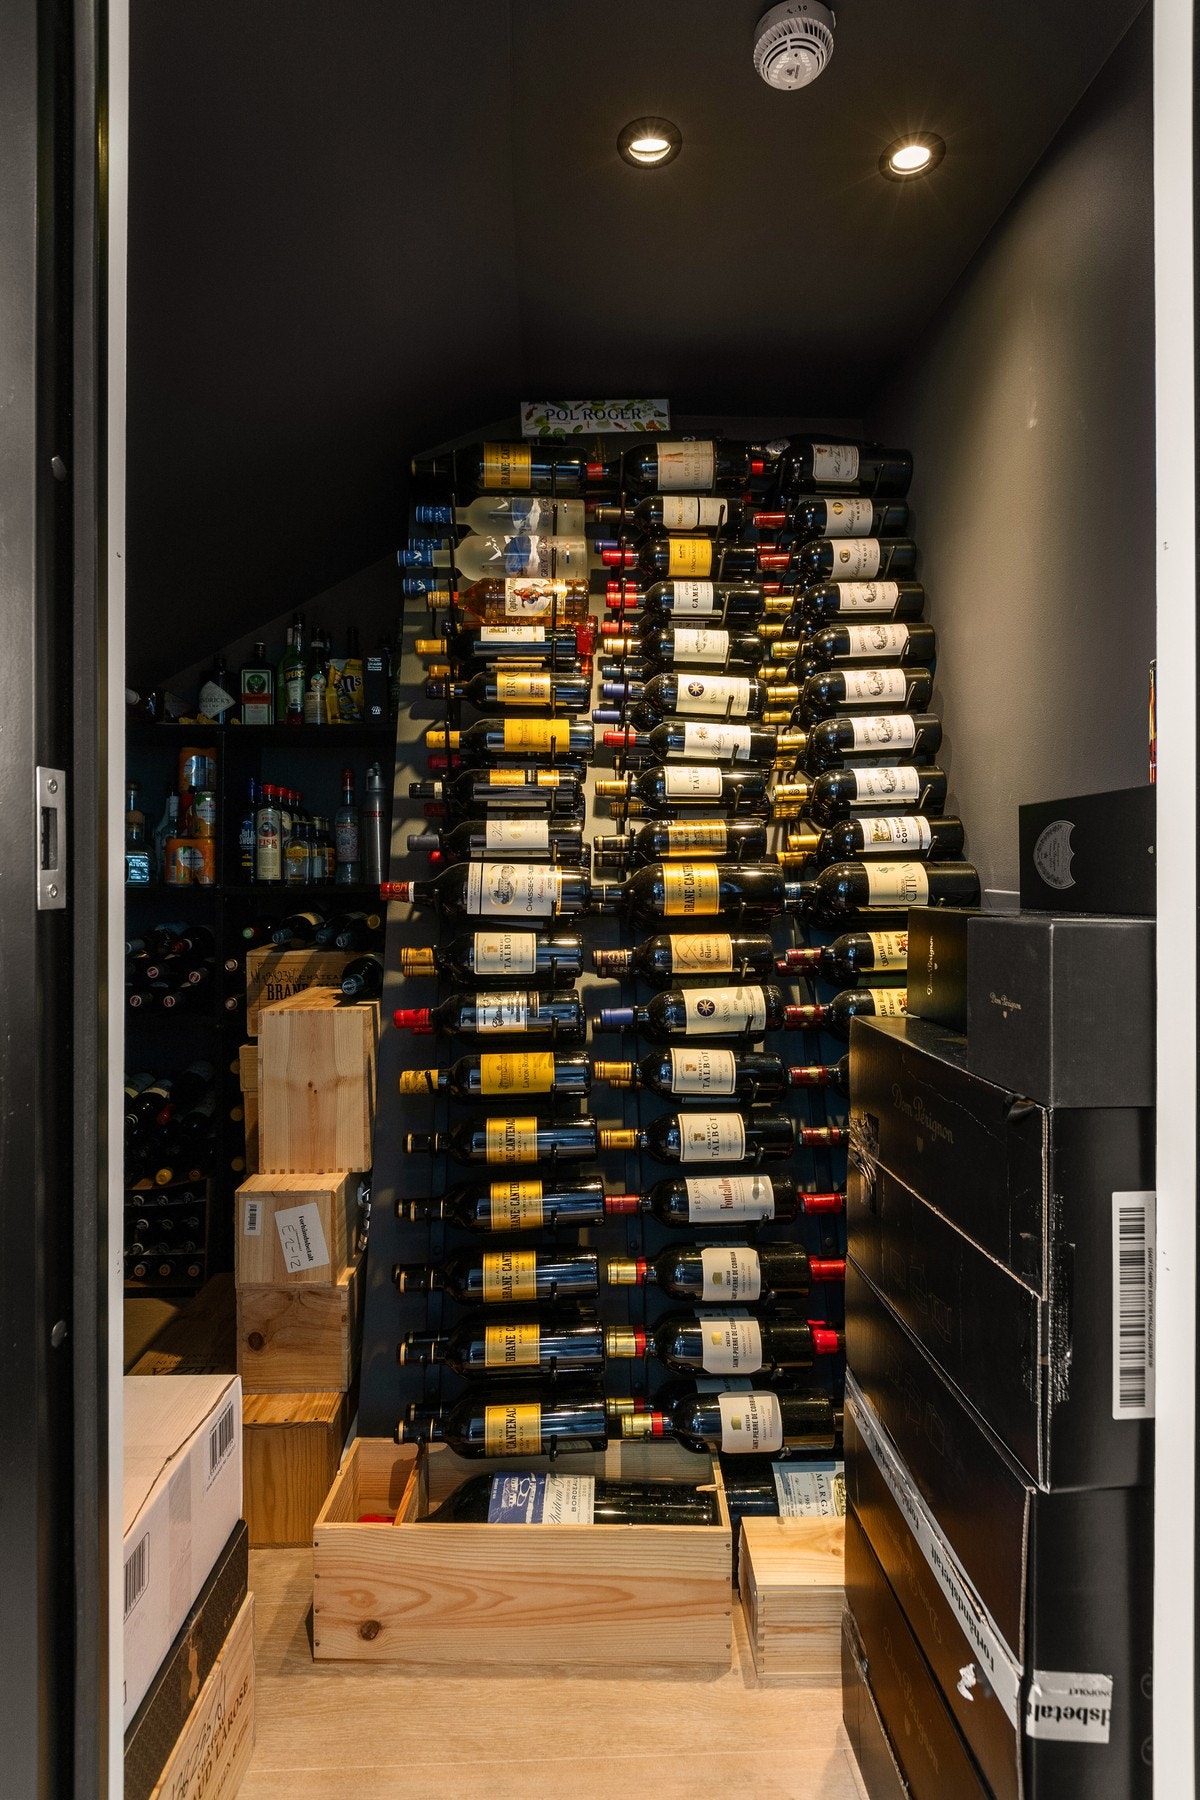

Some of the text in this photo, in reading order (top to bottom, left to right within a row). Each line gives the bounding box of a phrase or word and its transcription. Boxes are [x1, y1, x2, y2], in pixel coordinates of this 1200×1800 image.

[544, 407, 643, 421] POL ROGER
[540, 559, 549, 577] GREY
[702, 1051, 711, 1089] TALBOT
[891, 1083, 955, 1144] Dom Pérignon
[710, 1117, 720, 1157] TALBOT
[299, 1215, 314, 1262] Forhåndsbetalt
[930, 1543, 995, 1672] Forhåndsbetalt
[215, 1676, 248, 1760] LAROSE
